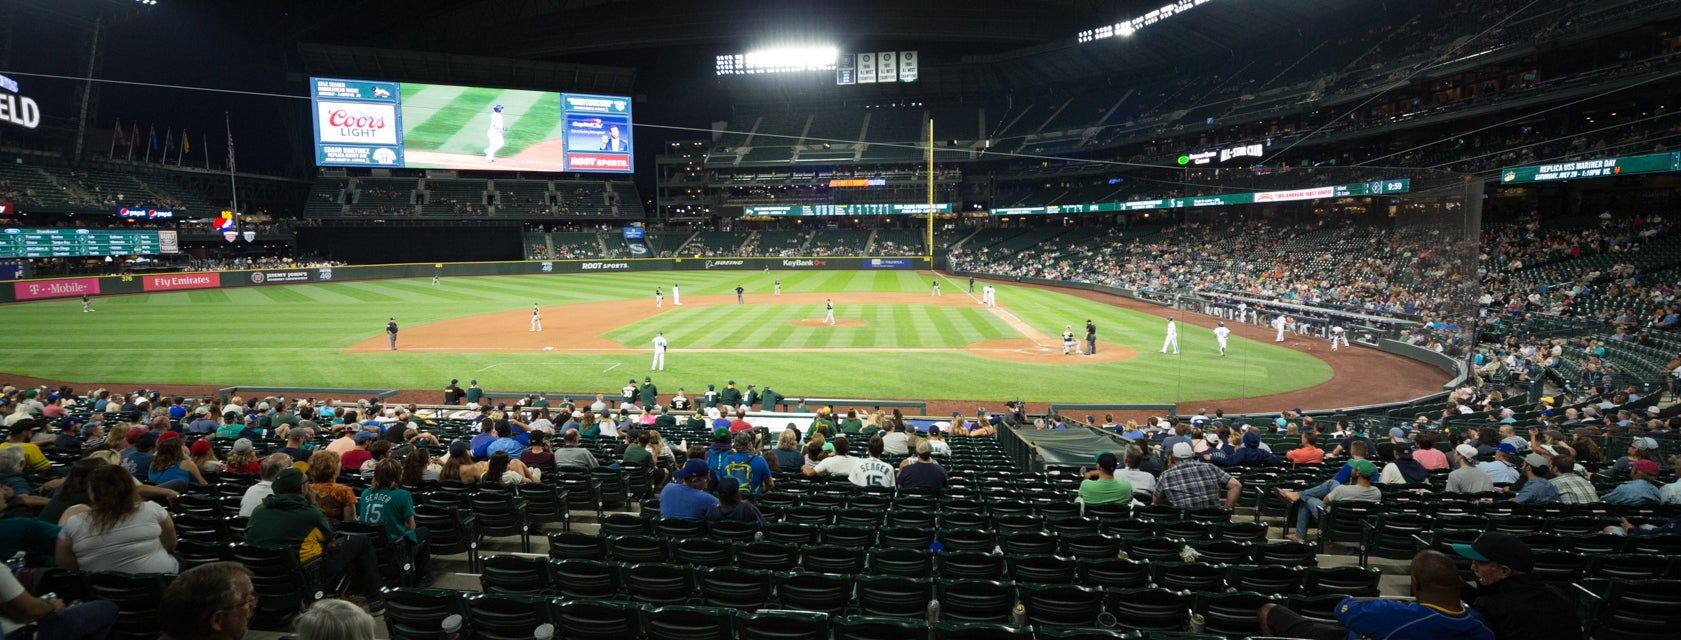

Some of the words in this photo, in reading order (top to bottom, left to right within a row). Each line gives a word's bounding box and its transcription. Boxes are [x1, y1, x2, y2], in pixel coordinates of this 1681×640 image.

[328, 109, 387, 129] Coors
[340, 128, 377, 137] LIGHT
[1246, 144, 1263, 157] CLUB
[571, 157, 596, 166] ROOT
[1540, 164, 1563, 173] REPLICA
[1564, 162, 1575, 171] USS
[1576, 160, 1603, 170] MARINER
[1604, 159, 1617, 167] DAY
[582, 262, 603, 270] ROOT
[783, 259, 814, 267] KeyBank
[155, 278, 170, 286] Fly
[171, 276, 210, 285] Emirates
[623, 390, 633, 398] 30
[860, 462, 890, 475] SEAGER
[865, 474, 883, 486] 15
[365, 493, 391, 503] SEAGER
[365, 503, 383, 523] 15
